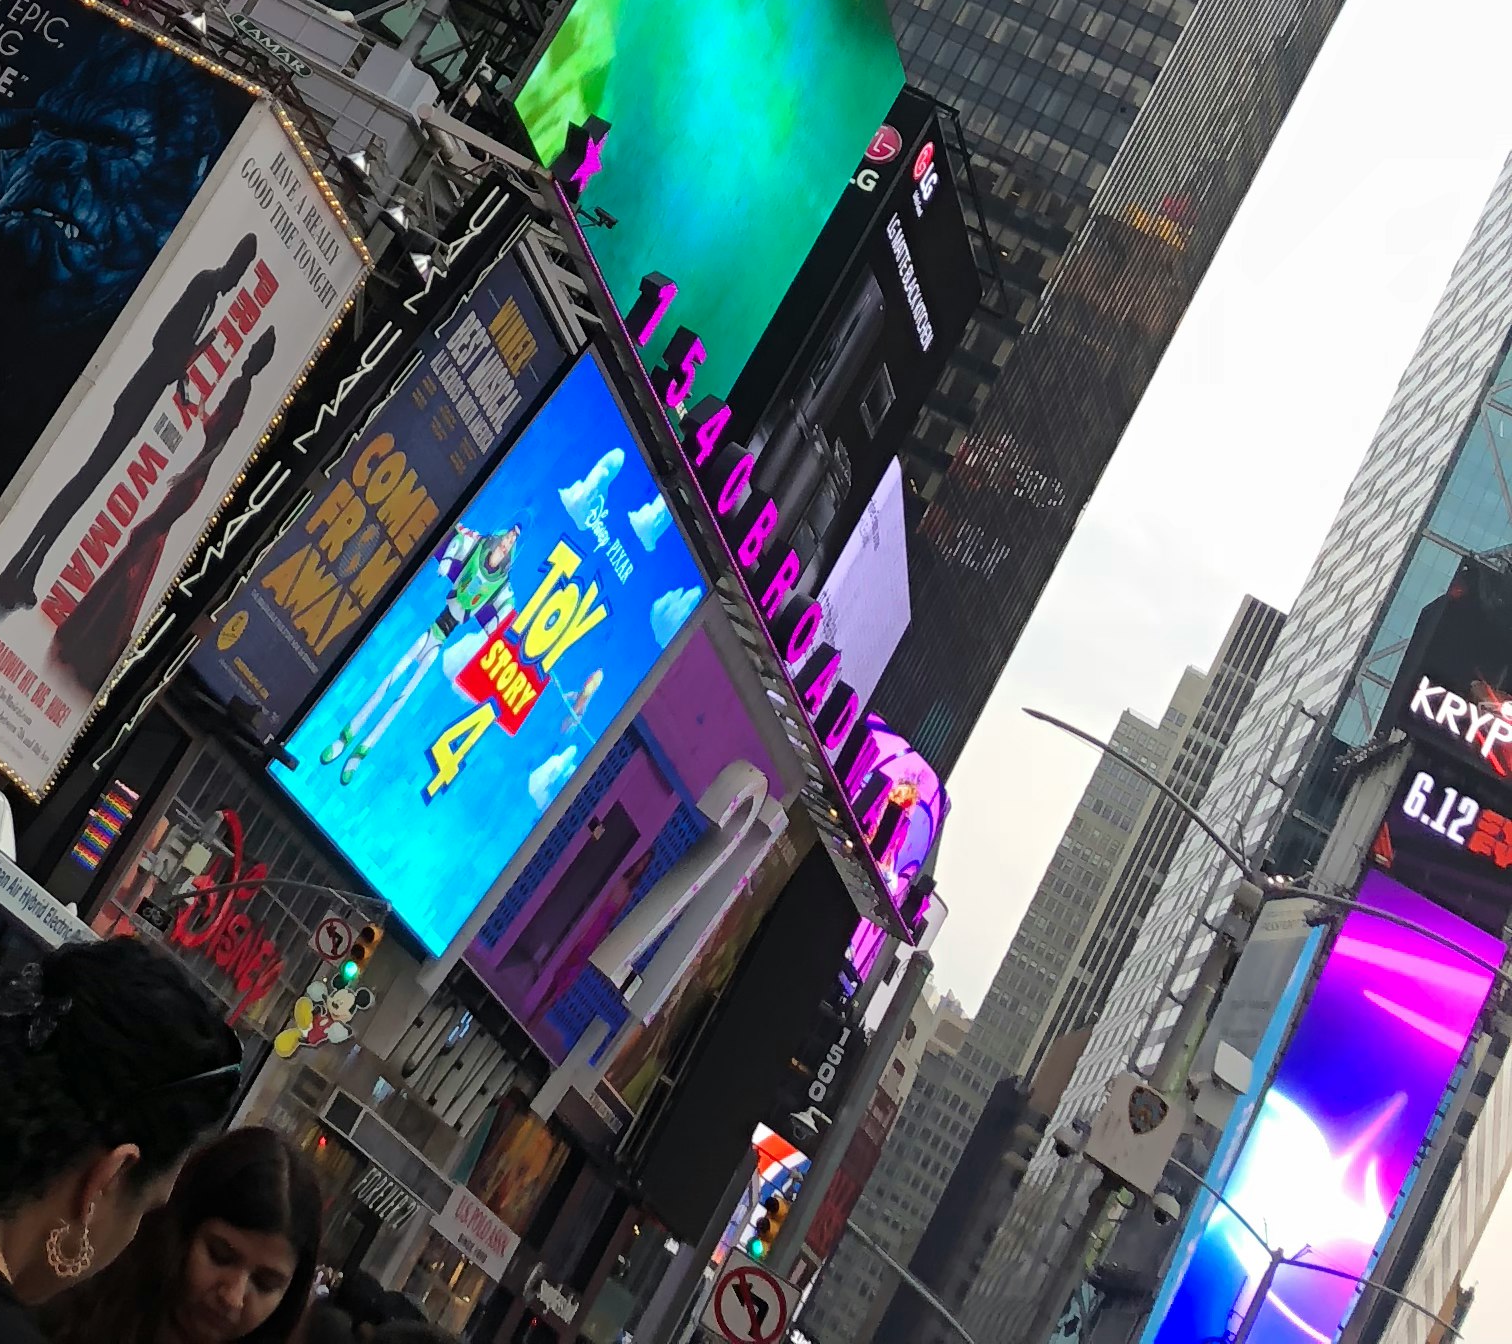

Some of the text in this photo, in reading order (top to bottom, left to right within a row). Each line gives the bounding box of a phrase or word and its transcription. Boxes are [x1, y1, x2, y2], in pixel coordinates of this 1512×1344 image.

[239, 19, 305, 73] LAMAR
[241, 157, 338, 310] GOOD TIME TONIGHT
[269, 151, 341, 266] HAVE A REALLY
[173, 258, 279, 433] PRETTY
[430, 349, 449, 376] ALL
[446, 310, 522, 434] BEST MUSICAL
[41, 441, 169, 629] WOMAN
[305, 478, 403, 610] FROM
[351, 432, 441, 555] COME
[260, 543, 363, 657] AWAY
[509, 537, 610, 676] TOY
[606, 537, 634, 585] PIXAR
[480, 638, 537, 715] STORY
[425, 700, 498, 799] 4
[1402, 771, 1480, 846] 6.12
[6, 876, 23, 898] Air
[18, 886, 49, 920] Hybrid
